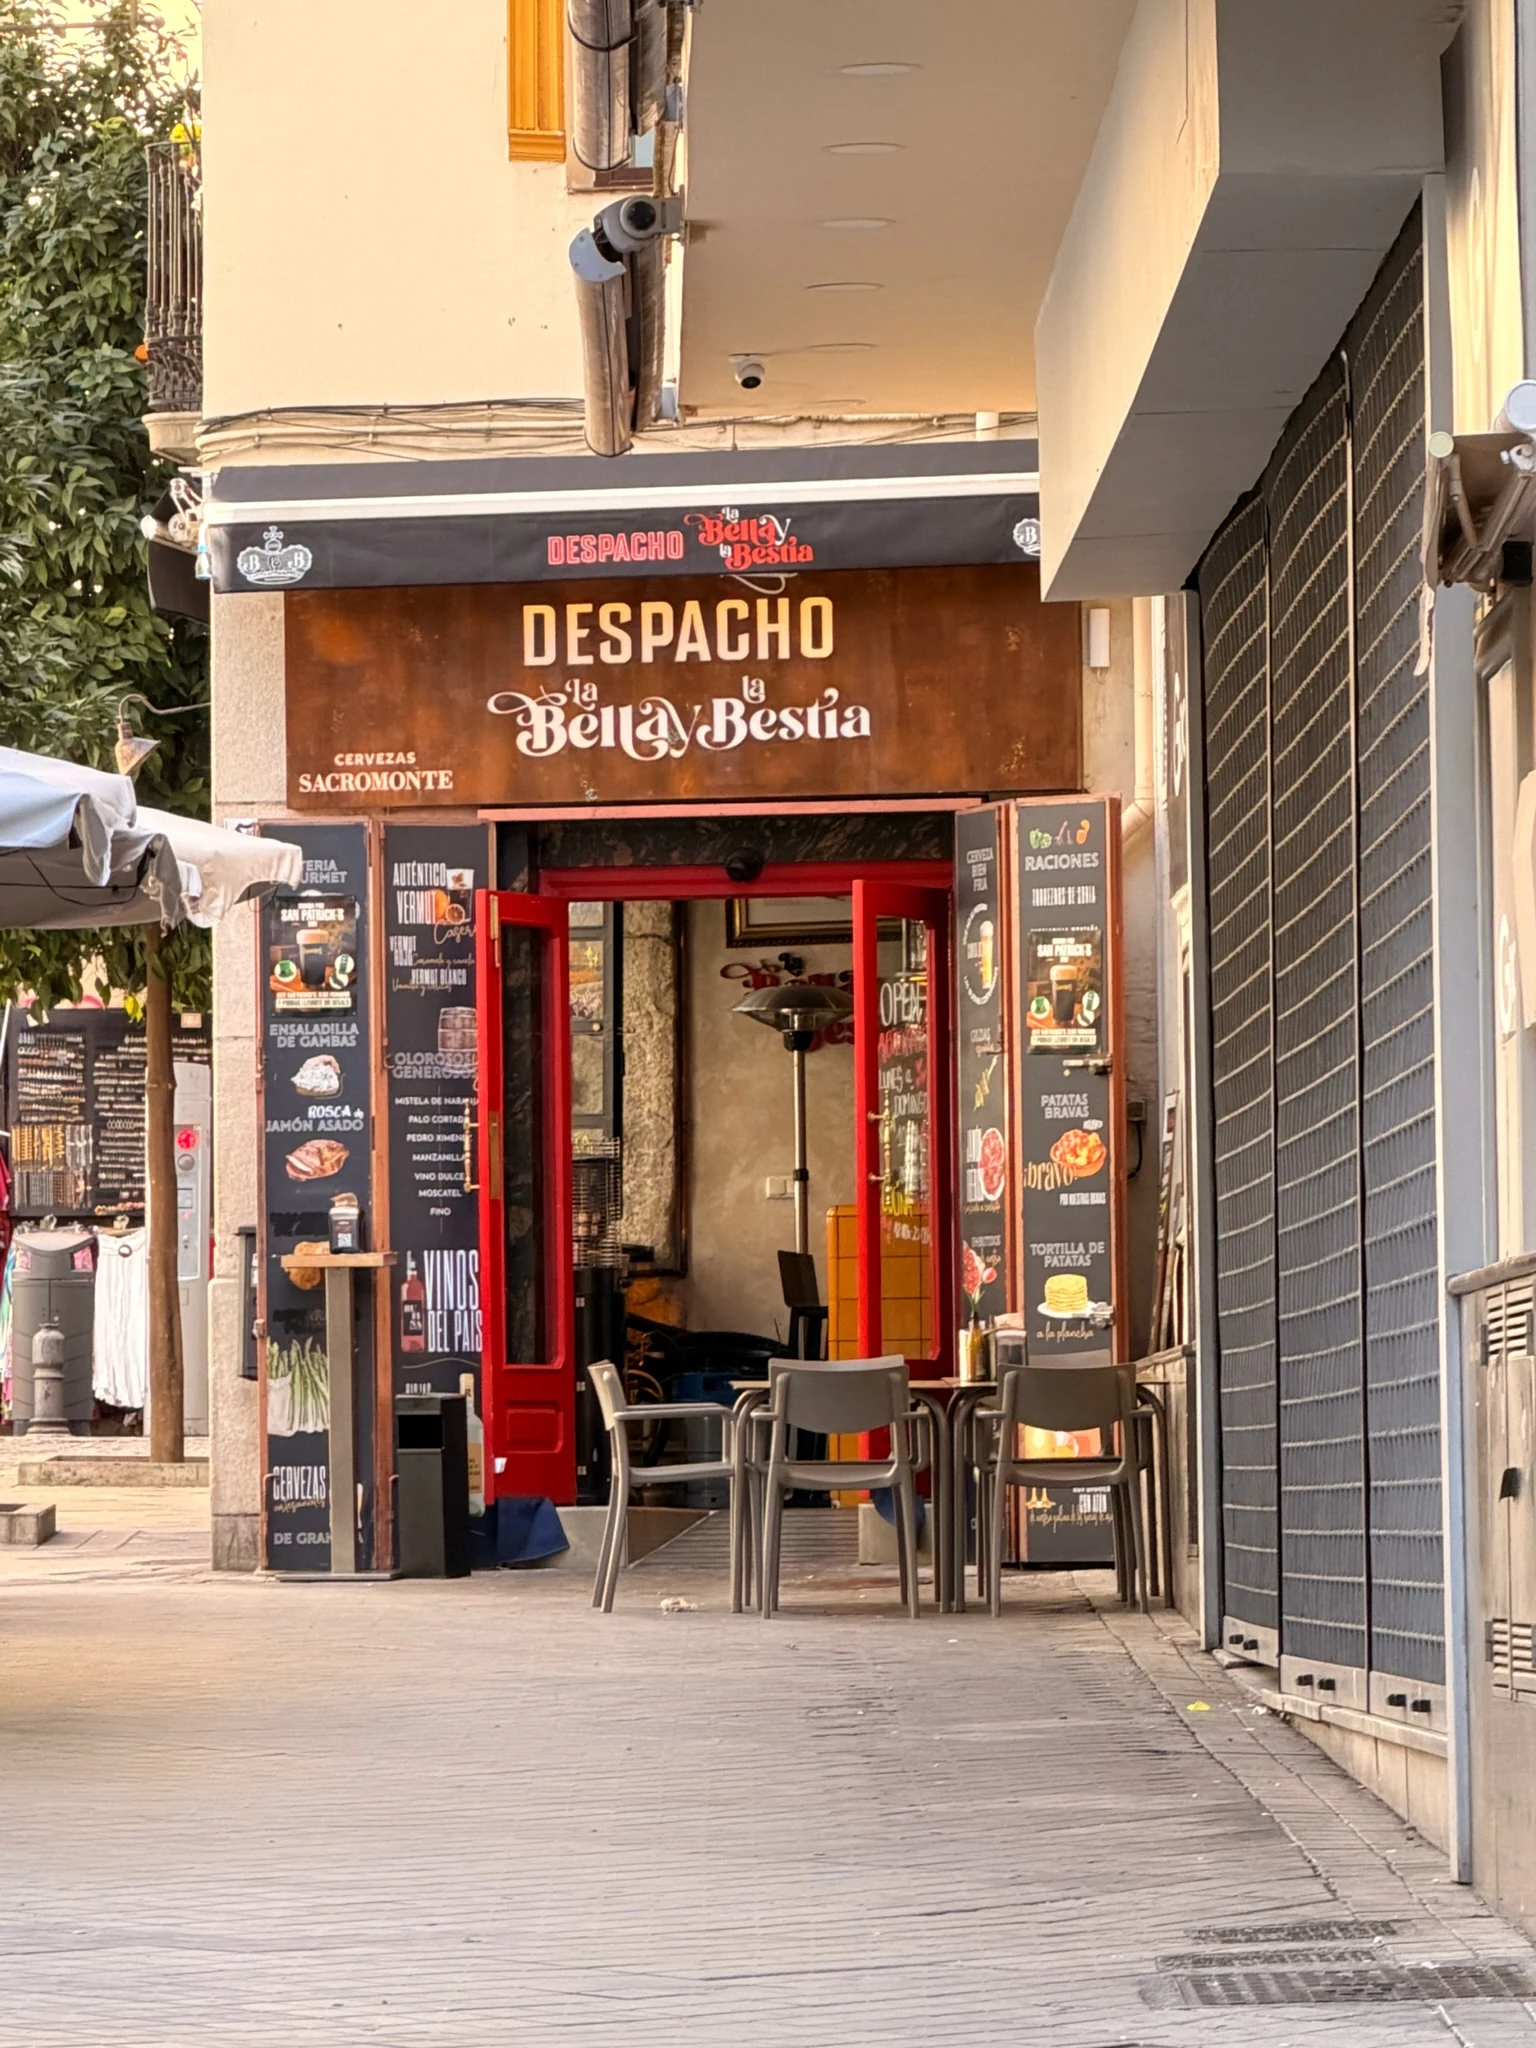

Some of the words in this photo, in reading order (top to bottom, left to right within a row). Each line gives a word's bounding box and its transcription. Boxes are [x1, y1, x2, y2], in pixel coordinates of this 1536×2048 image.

[547, 530, 684, 566] DESPACHO
[725, 536, 813, 571] Bestia
[522, 596, 834, 667] DESPACHO
[487, 684, 671, 762] Bella
[695, 687, 871, 751] Bestia
[334, 752, 416, 766] CERVEZAS
[299, 770, 453, 792] SACROMONTE
[1025, 852, 1099, 871] RACIONES
[301, 870, 347, 884] URMET
[393, 860, 446, 887] AUTÉNTICO
[281, 909, 299, 921] SAN
[397, 890, 437, 925] VERMUT
[434, 919, 476, 945] Caser
[1037, 944, 1053, 957] SAN
[411, 968, 438, 985] VERMUT
[440, 968, 467, 986] BLANCO
[880, 981, 922, 1027] OPEN
[269, 1022, 360, 1036] ENSALADILLA
[277, 1036, 296, 1048] DE
[300, 1035, 357, 1047] GAMBAS
[878, 1066, 903, 1093] LUNES
[395, 1096, 429, 1105] MISTELA
[431, 1096, 442, 1105] DE
[1041, 1093, 1088, 1107] PATATAS
[308, 1104, 351, 1119] ROSCA
[408, 1115, 430, 1123] PALO
[431, 1115, 465, 1123] CORTAD
[1044, 1105, 1089, 1119] BRAVAS
[266, 1116, 313, 1132] JAMÓN
[317, 1119, 364, 1131] ASADO
[406, 1133, 434, 1142] PEDRO
[414, 1172, 436, 1181] VINO
[438, 1172, 465, 1181] DULCE
[418, 1189, 462, 1197] MOSCATEL
[430, 1207, 451, 1216] FINO
[1030, 1241, 1086, 1256] TORTILLA
[1089, 1241, 1104, 1254] DE
[1044, 1253, 1091, 1268] PATATAS
[423, 1249, 480, 1310] VINOS
[427, 1310, 450, 1352] DEL
[273, 1466, 326, 1500] CERVEZAS
[274, 1532, 292, 1544] DE
